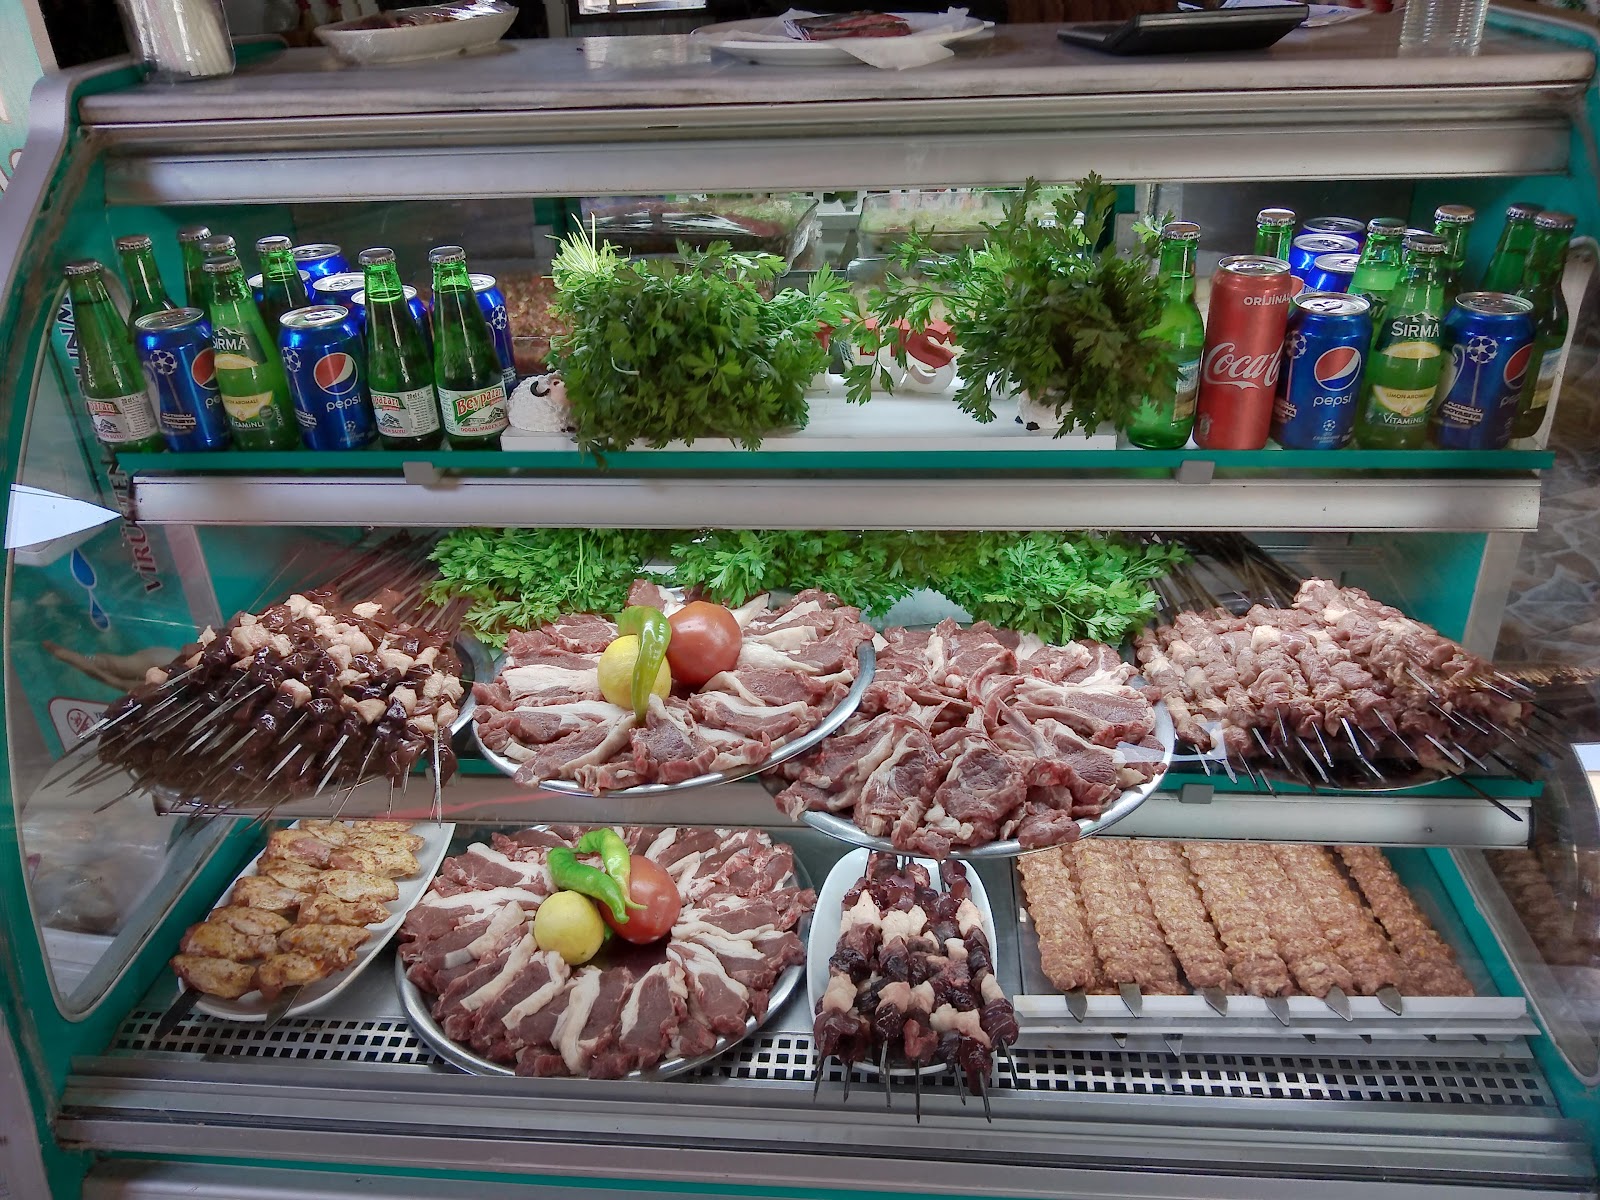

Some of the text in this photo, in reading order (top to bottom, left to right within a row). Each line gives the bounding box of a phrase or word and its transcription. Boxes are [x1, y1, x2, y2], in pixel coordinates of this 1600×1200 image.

[1390, 321, 1440, 338] SIRMA
[326, 393, 362, 412] pepsi
[1312, 393, 1352, 407] pepsi
